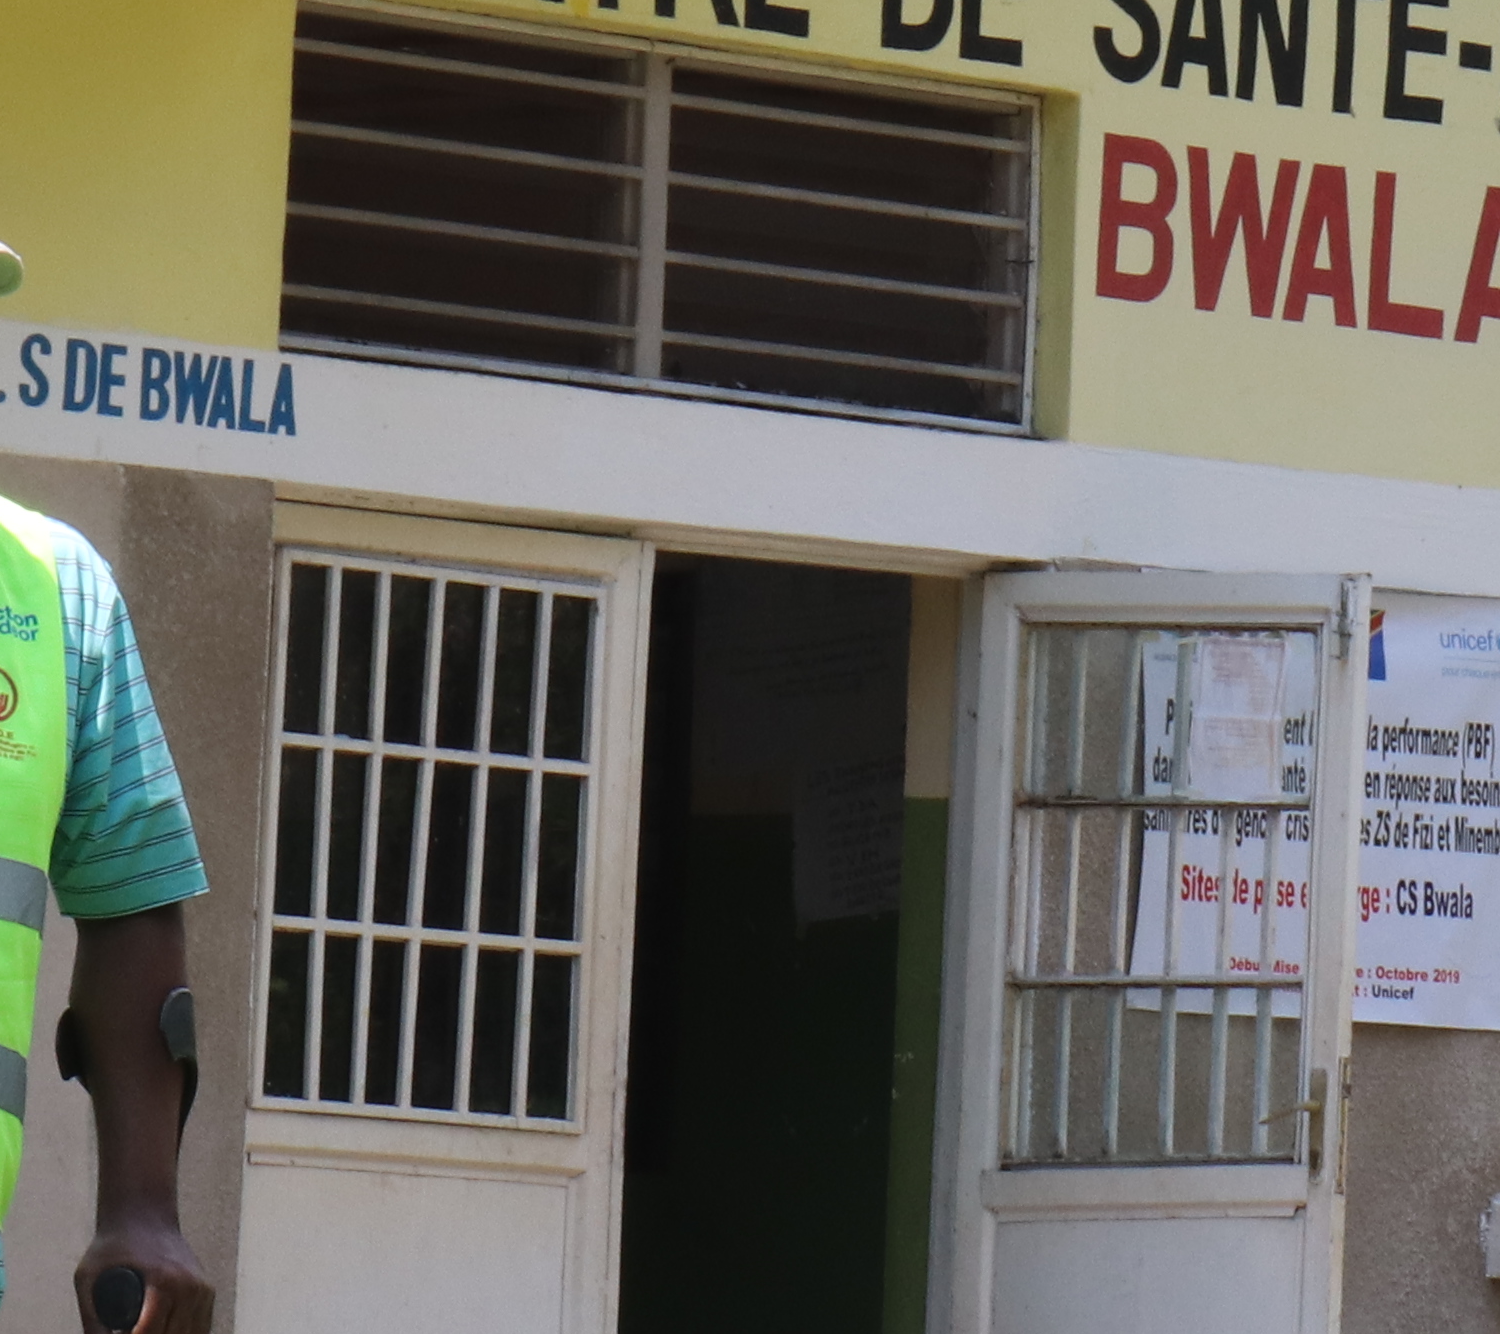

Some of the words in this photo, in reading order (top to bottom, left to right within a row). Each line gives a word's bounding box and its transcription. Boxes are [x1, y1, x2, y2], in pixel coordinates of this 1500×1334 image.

[62, 337, 128, 417] DE
[139, 347, 297, 437] BWALA
[1439, 627, 1494, 652] unicef
[1366, 715, 1379, 751] la
[1382, 718, 1460, 761] performance
[1461, 722, 1496, 769] (PBF)
[1364, 770, 1381, 799] en
[1383, 763, 1432, 810] réponse
[1433, 775, 1457, 805] aux
[1372, 810, 1391, 847] ZS
[1393, 812, 1409, 849] de
[1412, 813, 1434, 851] Fizi
[1437, 816, 1451, 852] et
[1396, 879, 1418, 916] CS
[1423, 881, 1474, 920] Bwala
[1371, 983, 1416, 1000] Unicef
[1375, 965, 1429, 982] Octobre
[1432, 968, 1461, 984] 2019
